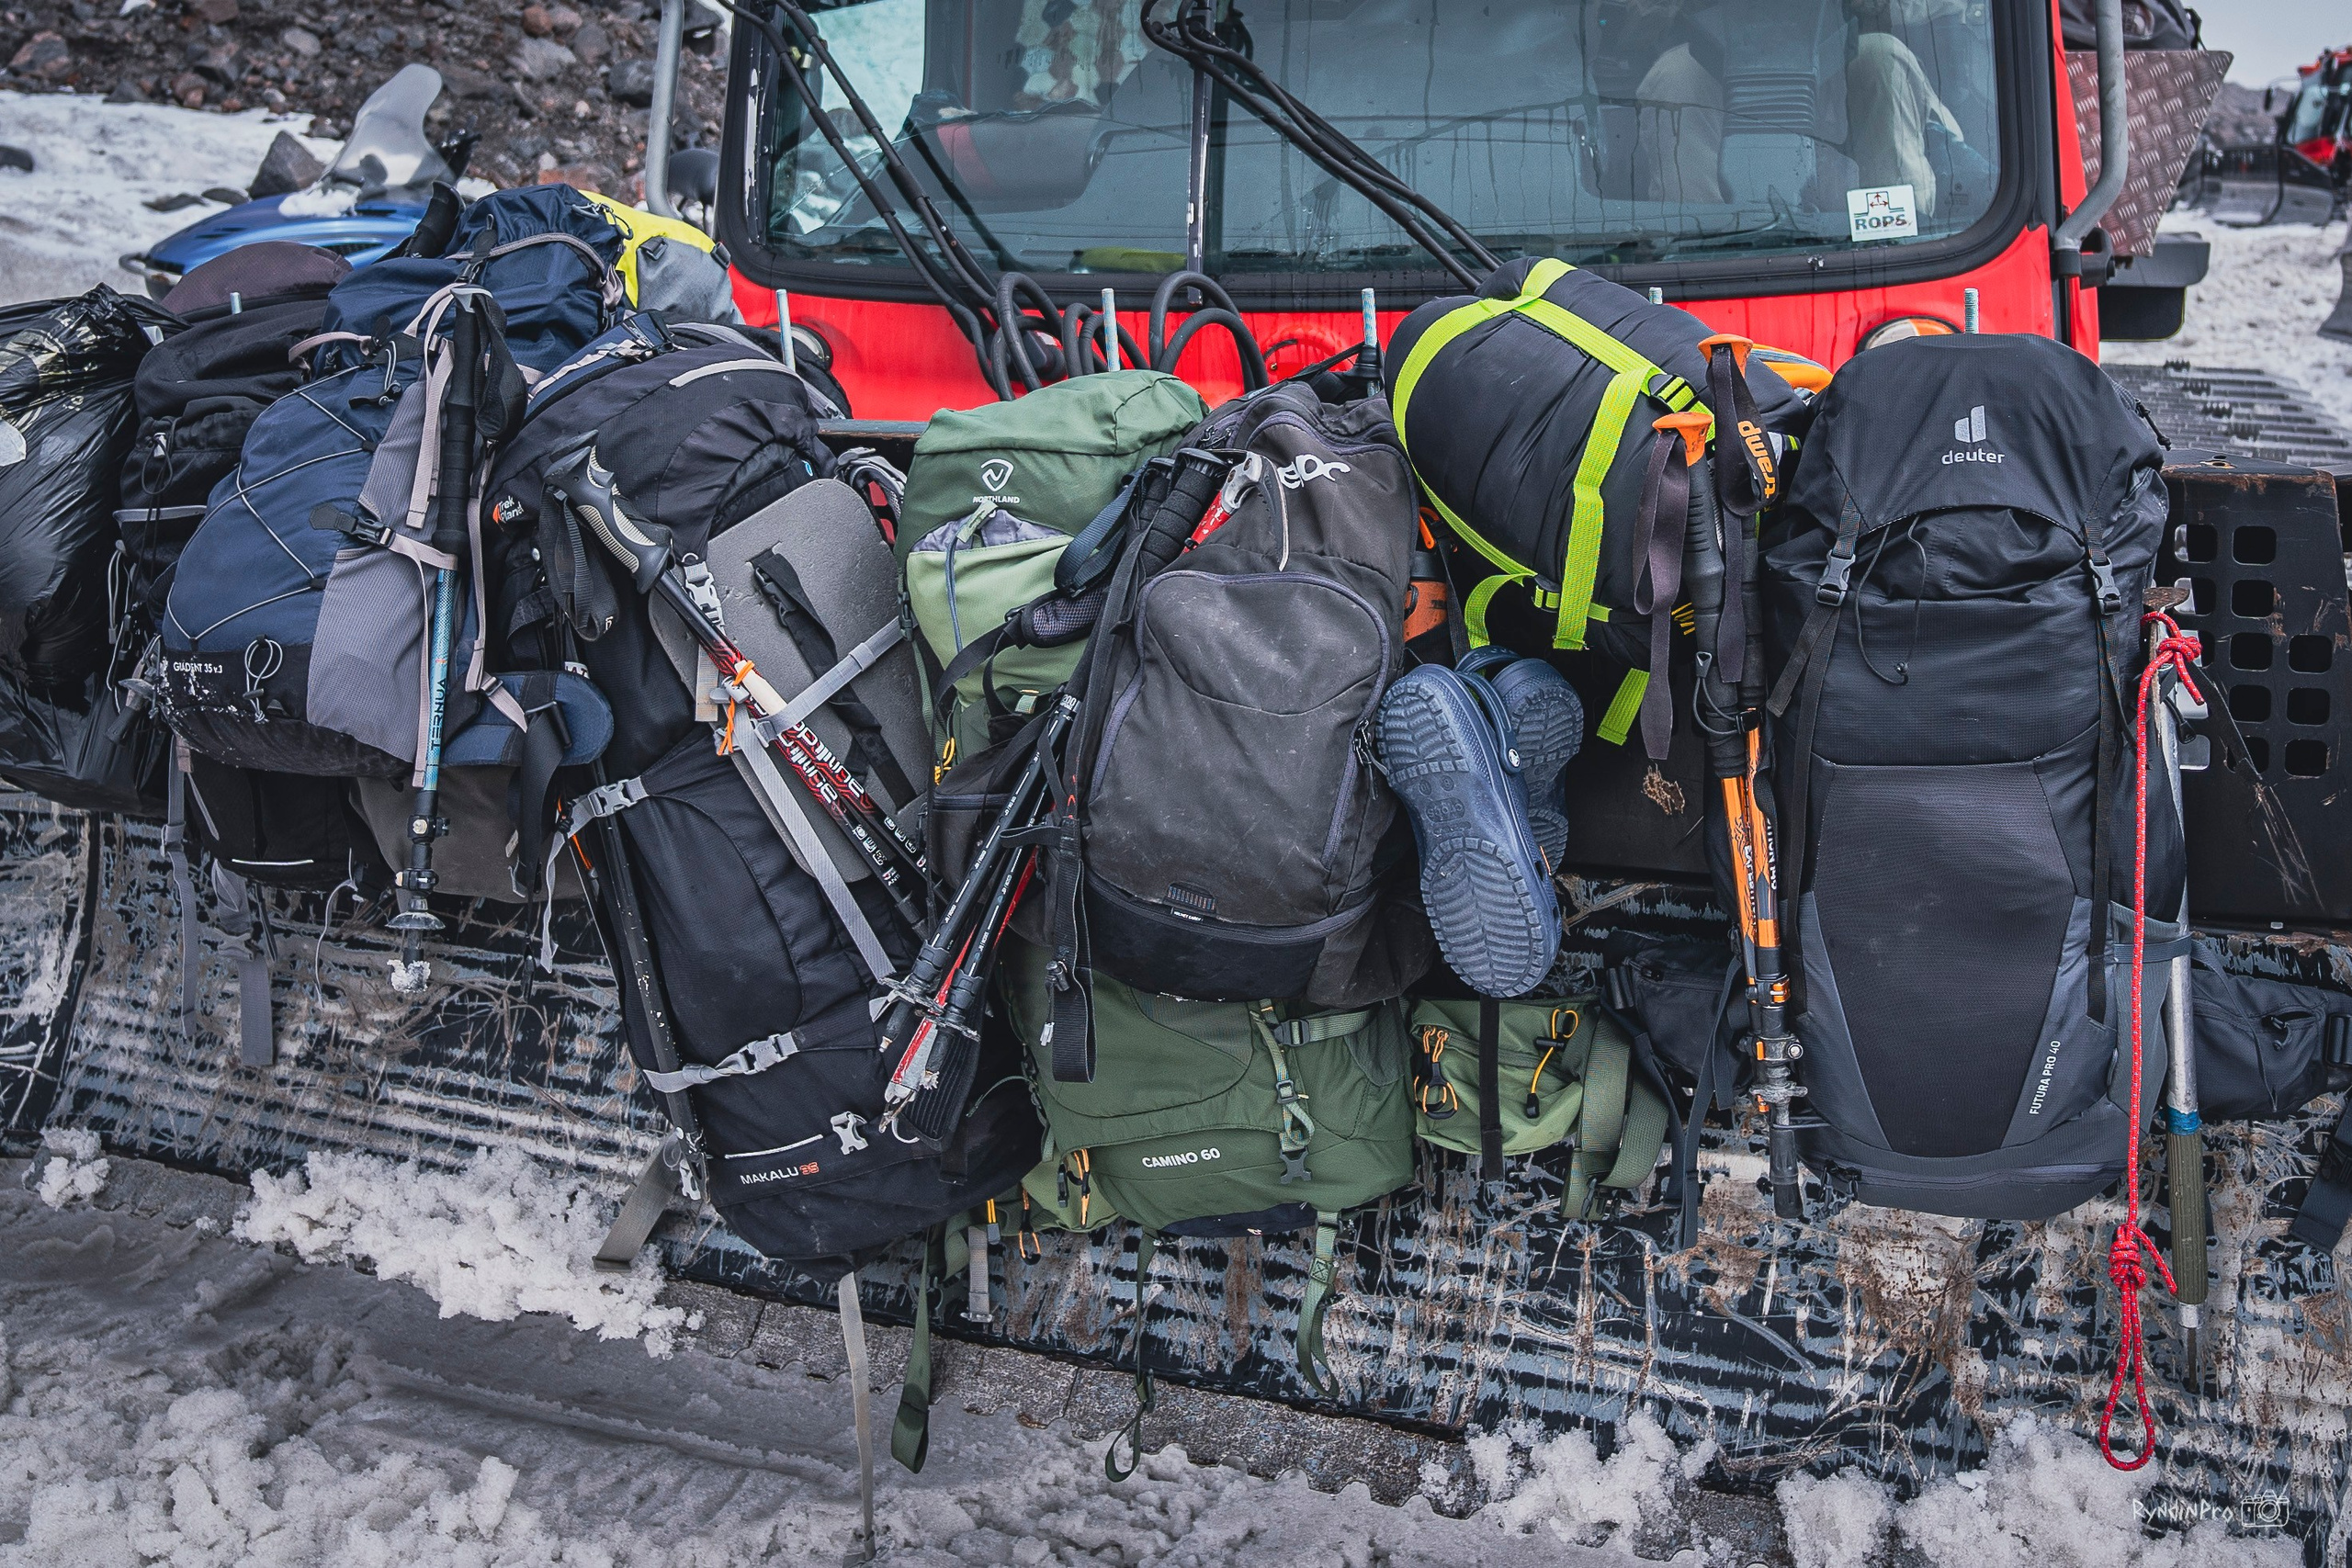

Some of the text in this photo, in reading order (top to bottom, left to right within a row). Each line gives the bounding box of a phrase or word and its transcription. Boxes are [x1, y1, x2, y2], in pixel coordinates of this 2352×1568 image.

[1737, 420, 1776, 499] tramp
[1941, 447, 2006, 465] deuter
[498, 495, 515, 513] Trek
[430, 678, 447, 751] TERNUA
[2029, 1040, 2061, 1115] FUTURA PRO 40
[1142, 1147, 1221, 1168] CAMINO 60
[740, 1166, 799, 1185] MAKALU
